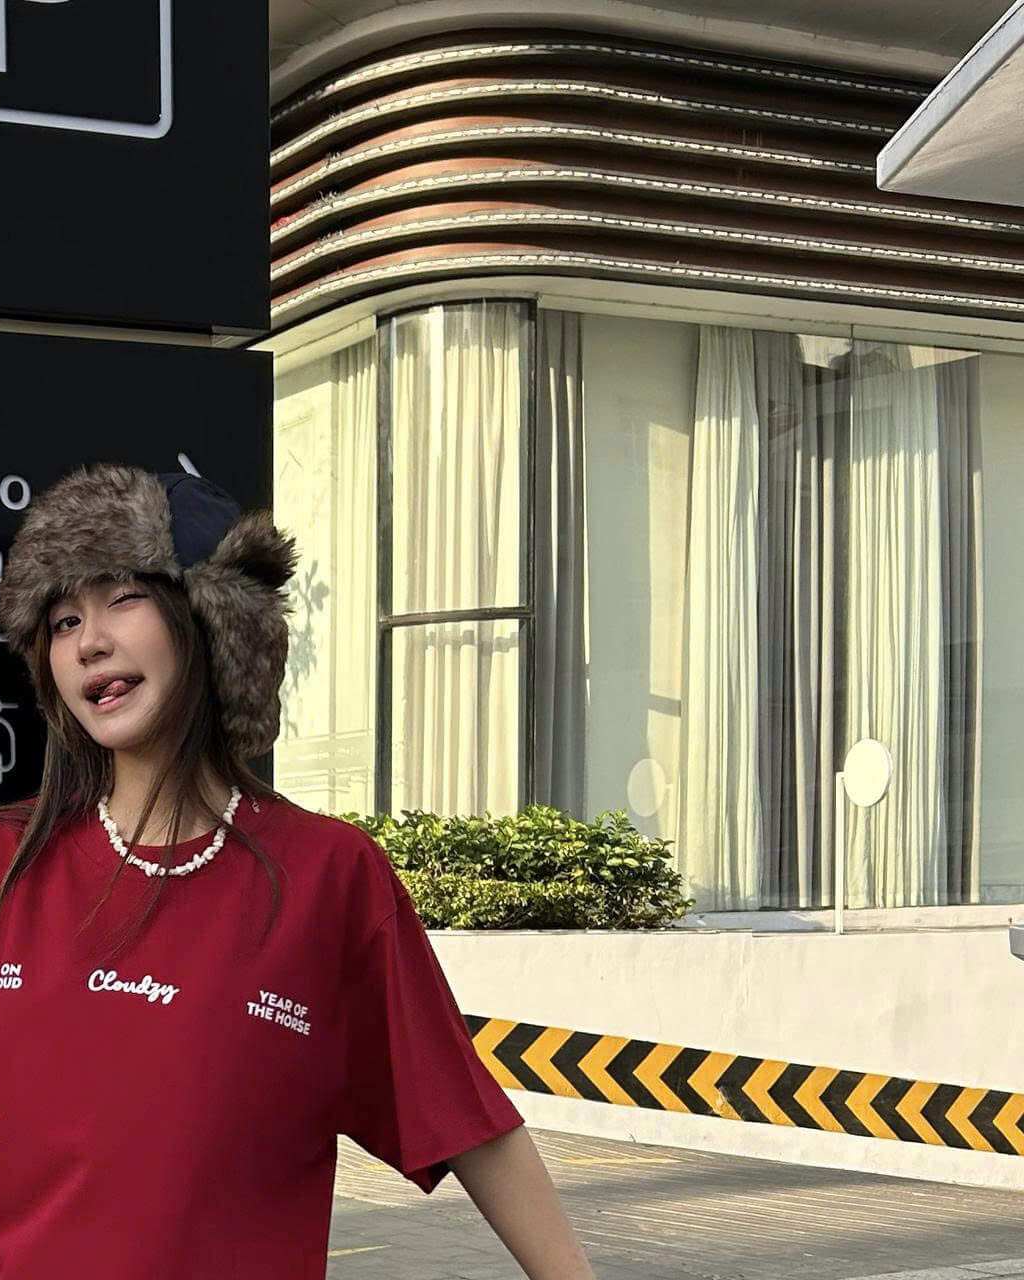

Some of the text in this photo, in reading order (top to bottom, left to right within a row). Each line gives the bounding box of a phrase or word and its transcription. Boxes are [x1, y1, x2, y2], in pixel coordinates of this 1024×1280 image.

[0, 962, 23, 976] ON
[88, 969, 180, 1005] Cloudzy
[247, 1001, 311, 1035] THE HORSE
[259, 990, 309, 1018] YEAR OF
